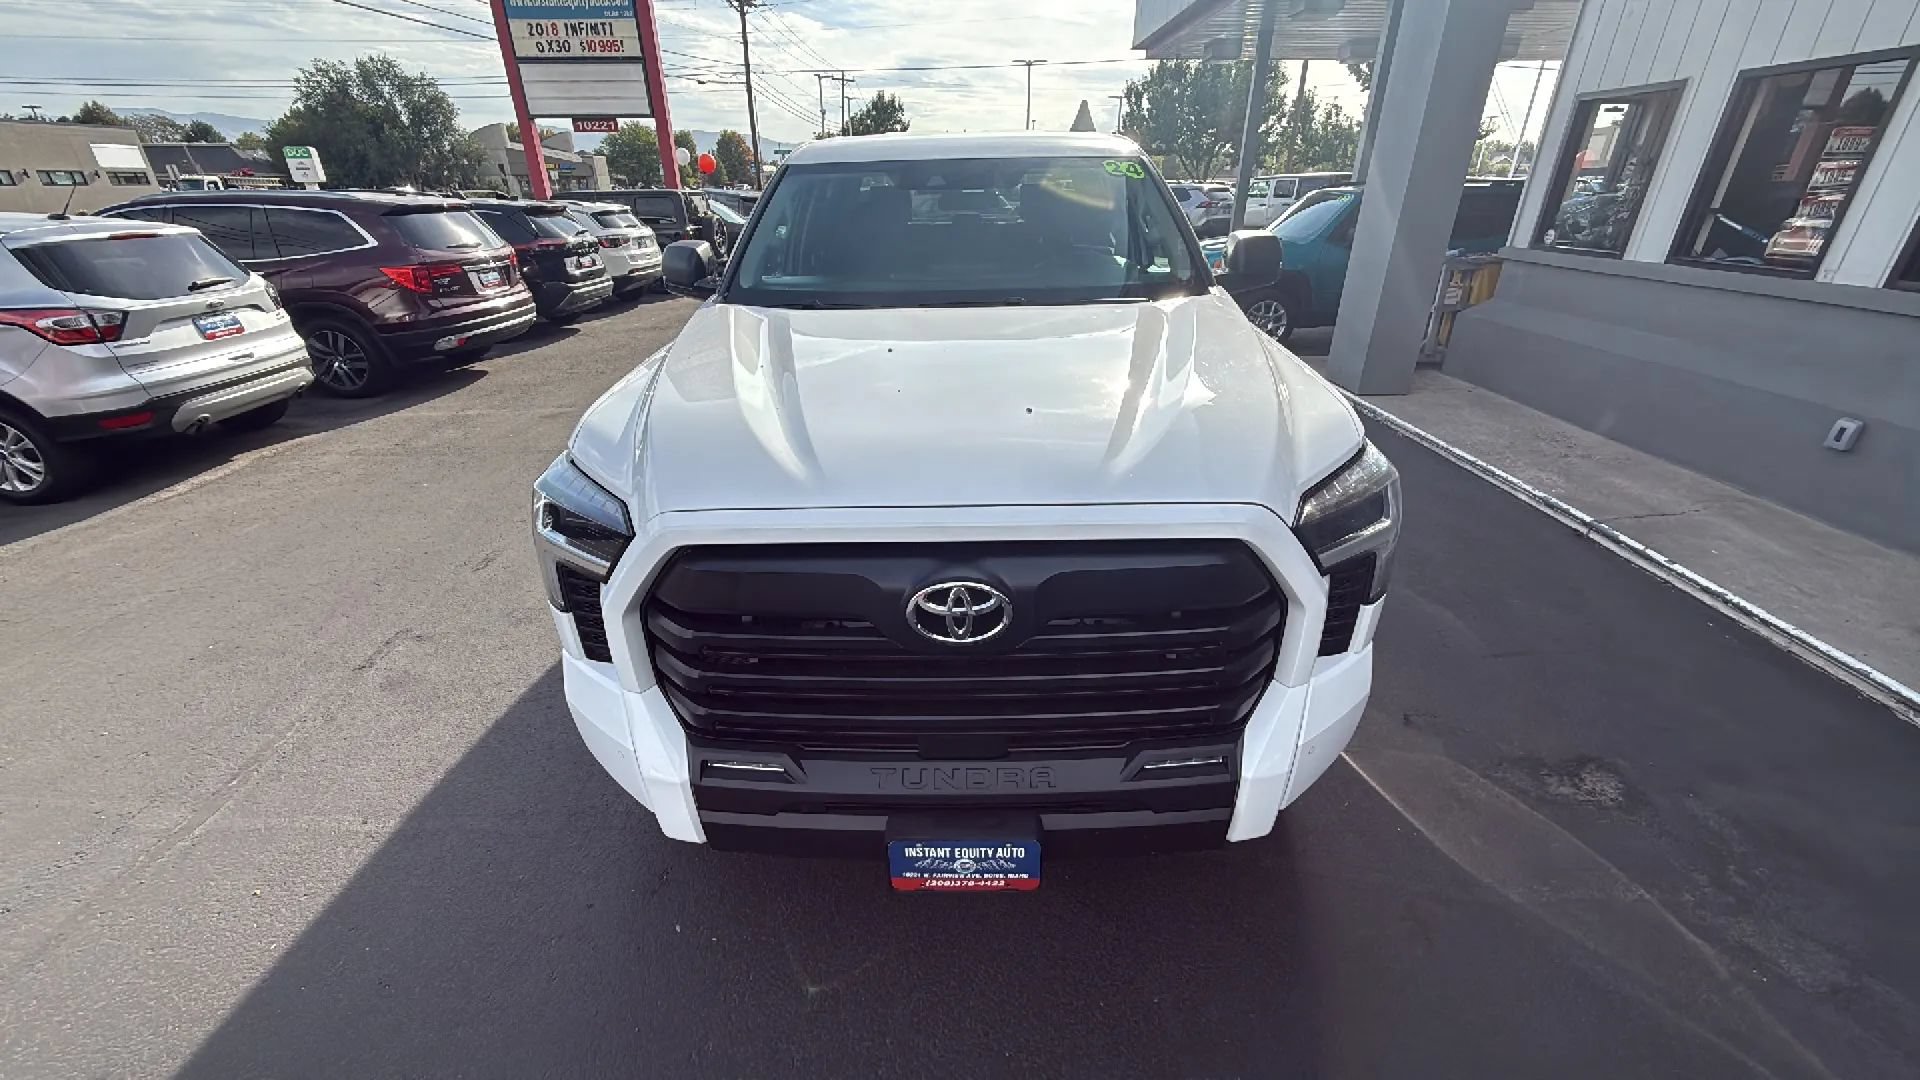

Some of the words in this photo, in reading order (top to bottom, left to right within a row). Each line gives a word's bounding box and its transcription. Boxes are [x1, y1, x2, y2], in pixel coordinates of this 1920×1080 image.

[527, 22, 559, 37] 2018
[564, 22, 614, 37] INFINITI
[536, 39, 571, 53] QX30
[575, 121, 615, 131] 10221
[1103, 160, 1144, 178] 24
[869, 766, 1057, 790] TUNDRA
[904, 847, 951, 858] INSTANT
[954, 847, 994, 859] EQUITY
[996, 847, 1026, 858] AUTO
